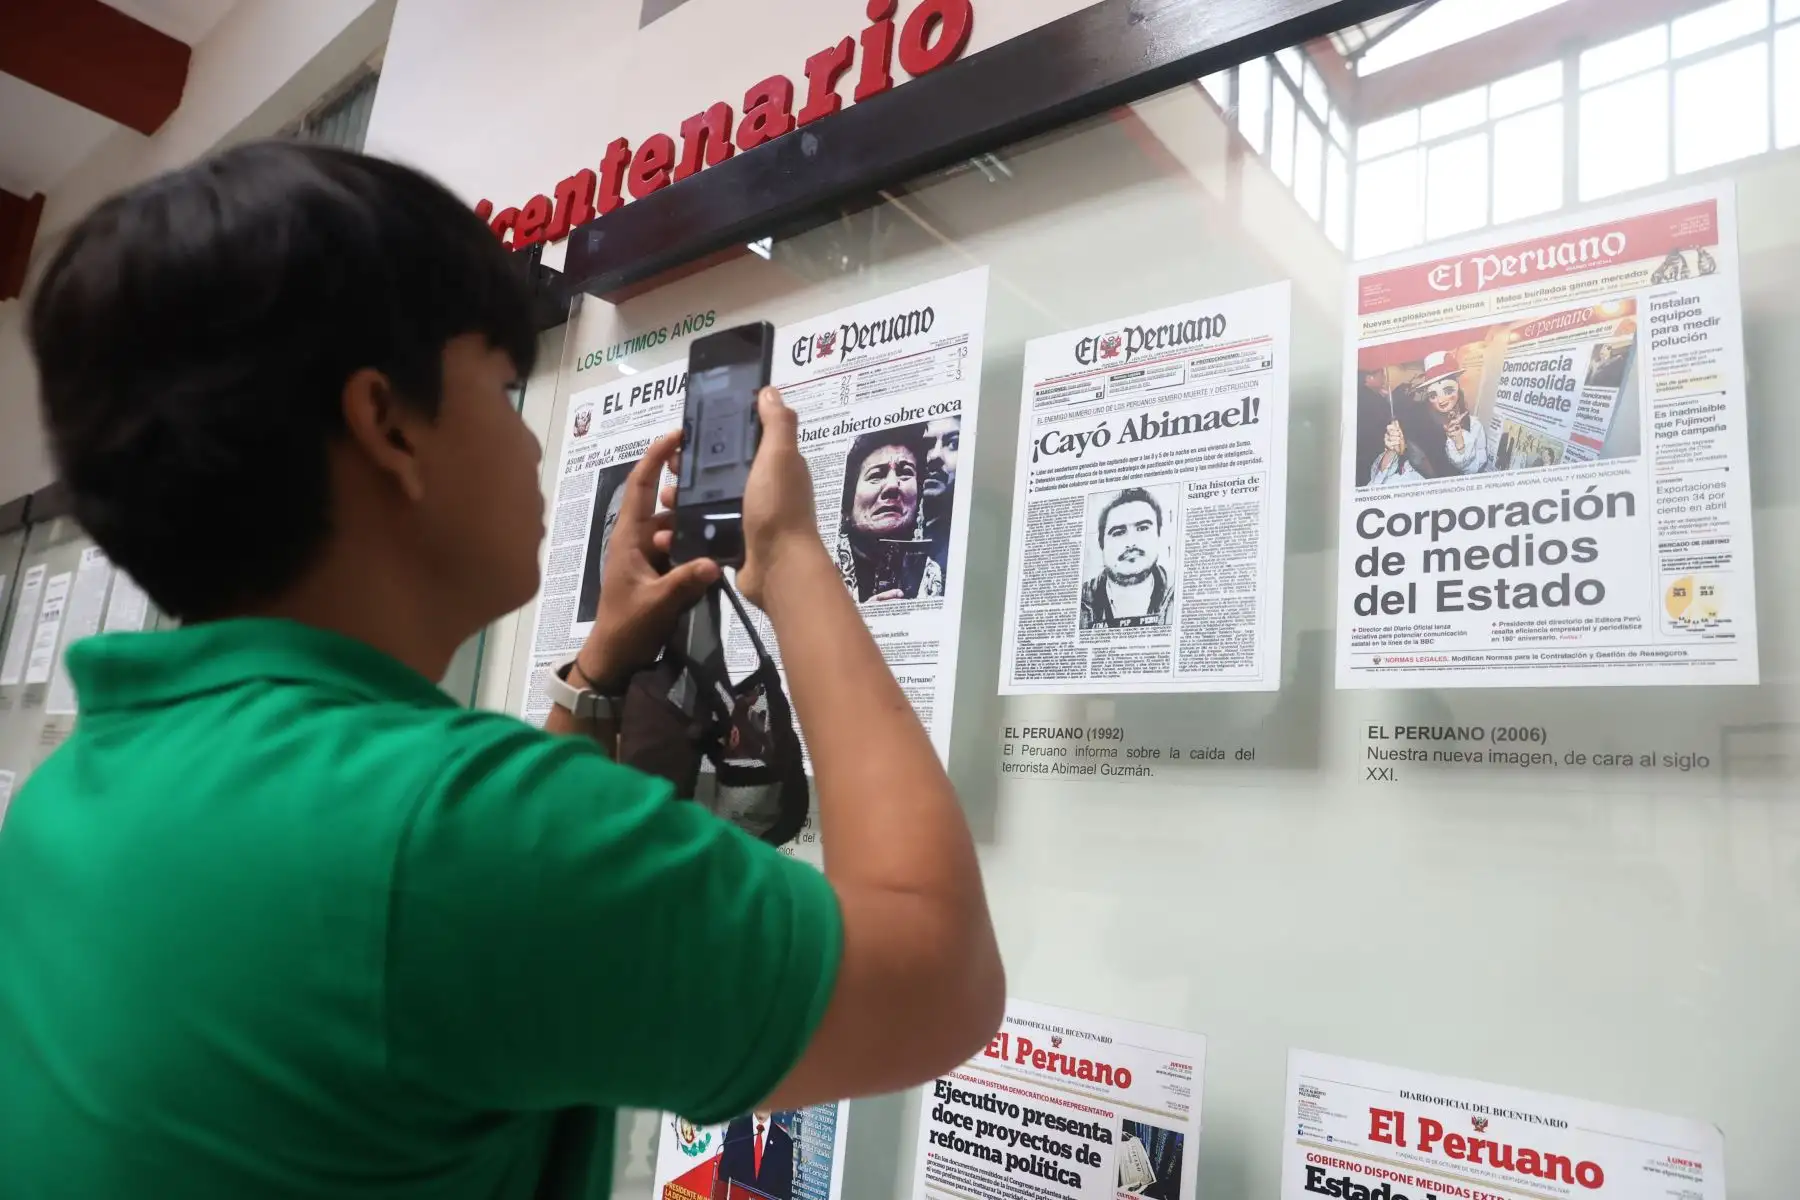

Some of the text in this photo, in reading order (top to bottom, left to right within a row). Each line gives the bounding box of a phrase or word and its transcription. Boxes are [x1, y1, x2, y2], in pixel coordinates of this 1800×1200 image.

[1427, 230, 1626, 292] El Peruano
[1524, 284, 1567, 299] burilados
[1569, 278, 1598, 291] ganan
[1600, 268, 1649, 285] mercados
[1650, 294, 1700, 312] Instalan
[1362, 319, 1391, 329] Nuevas
[1393, 308, 1441, 324] explosiones
[1442, 306, 1453, 314] en
[1650, 307, 1703, 325] equipos
[1651, 316, 1721, 338] para medir
[576, 309, 716, 372] LOS ULTIMOS AÑOS
[792, 332, 816, 366] El
[839, 305, 935, 363] Peruano
[1075, 313, 1227, 365] El Peruano
[1651, 332, 1708, 350] polución
[1502, 354, 1573, 373] Democracia
[602, 371, 689, 415] EL PERUA
[1500, 374, 1577, 392] se consolida
[1044, 411, 1067, 423] ENEMIGO
[1092, 406, 1104, 414] UNO
[1113, 402, 1125, 410] LOS
[1126, 396, 1157, 408] PERUANOS
[1183, 388, 1209, 399] MUERTE
[1496, 387, 1572, 413] con el debate
[1654, 403, 1726, 419] Es inadmisible
[832, 416, 882, 437] abierto
[883, 403, 925, 425] sobre
[927, 399, 962, 416] coca
[1031, 421, 1111, 464] ¡Cayó
[1116, 396, 1261, 444] Abimael!
[1654, 414, 1716, 430] que Fujimori
[1654, 423, 1727, 440] haga campaña
[587, 450, 600, 460] HOY
[603, 448, 611, 456] LA
[613, 438, 651, 453] PRESIDENCIA
[565, 465, 572, 474] DE
[575, 463, 582, 471] LA
[1188, 476, 1260, 491] Una historia de
[1188, 484, 1260, 499] sangre y terror
[1656, 480, 1726, 495] Exportaciones
[1656, 491, 1726, 505] crecen 34 por
[1656, 502, 1727, 515] ciento en abril
[1355, 484, 1636, 542] Corporación
[1354, 532, 1599, 579] de medios
[1353, 572, 1606, 617] del Estado
[1384, 655, 1414, 663] NORMAS
[1451, 654, 1484, 662] Modifican
[1514, 654, 1530, 662] para
[1541, 652, 1588, 660] Contratación
[1596, 650, 1626, 659] Gestión
[1628, 650, 1638, 658] de
[1004, 727, 1124, 741] EL PERUANO (1992)
[1368, 726, 1547, 745] EL PERUANO (2006)
[1003, 744, 1014, 756] El
[1021, 744, 1067, 757] Peruano
[1075, 744, 1118, 758] informa
[1126, 747, 1161, 759] sobre
[1169, 747, 1180, 759] la
[1234, 747, 1255, 761] del
[1367, 746, 1710, 772] Nuestra nueva imagen, de cara al siglo
[1002, 762, 1154, 777] terrorista Abimael Guzmán.
[1366, 767, 1398, 782] XXI.
[1006, 1015, 1113, 1044] DIARIO OFICIAL DEL BICENTENARIO
[983, 1032, 1132, 1089] El Peruano
[956, 1073, 977, 1083] LOGRAR
[977, 1078, 985, 1086] UN
[985, 1079, 1008, 1091] SISTEMA
[1062, 1100, 1114, 1118] REPRESENTATIVO
[934, 1079, 1113, 1145] Ejecutivo presenta
[1400, 1089, 1569, 1129] DIARIO OFICIAL DEL BICENTENARIO
[932, 1103, 1102, 1168] doce proyectos de
[929, 1129, 1082, 1189] reforma política
[1368, 1107, 1407, 1148] El
[1417, 1116, 1604, 1190] Peruano
[1306, 1152, 1470, 1199] GOBIERNO DISPONE MEDIDAS
